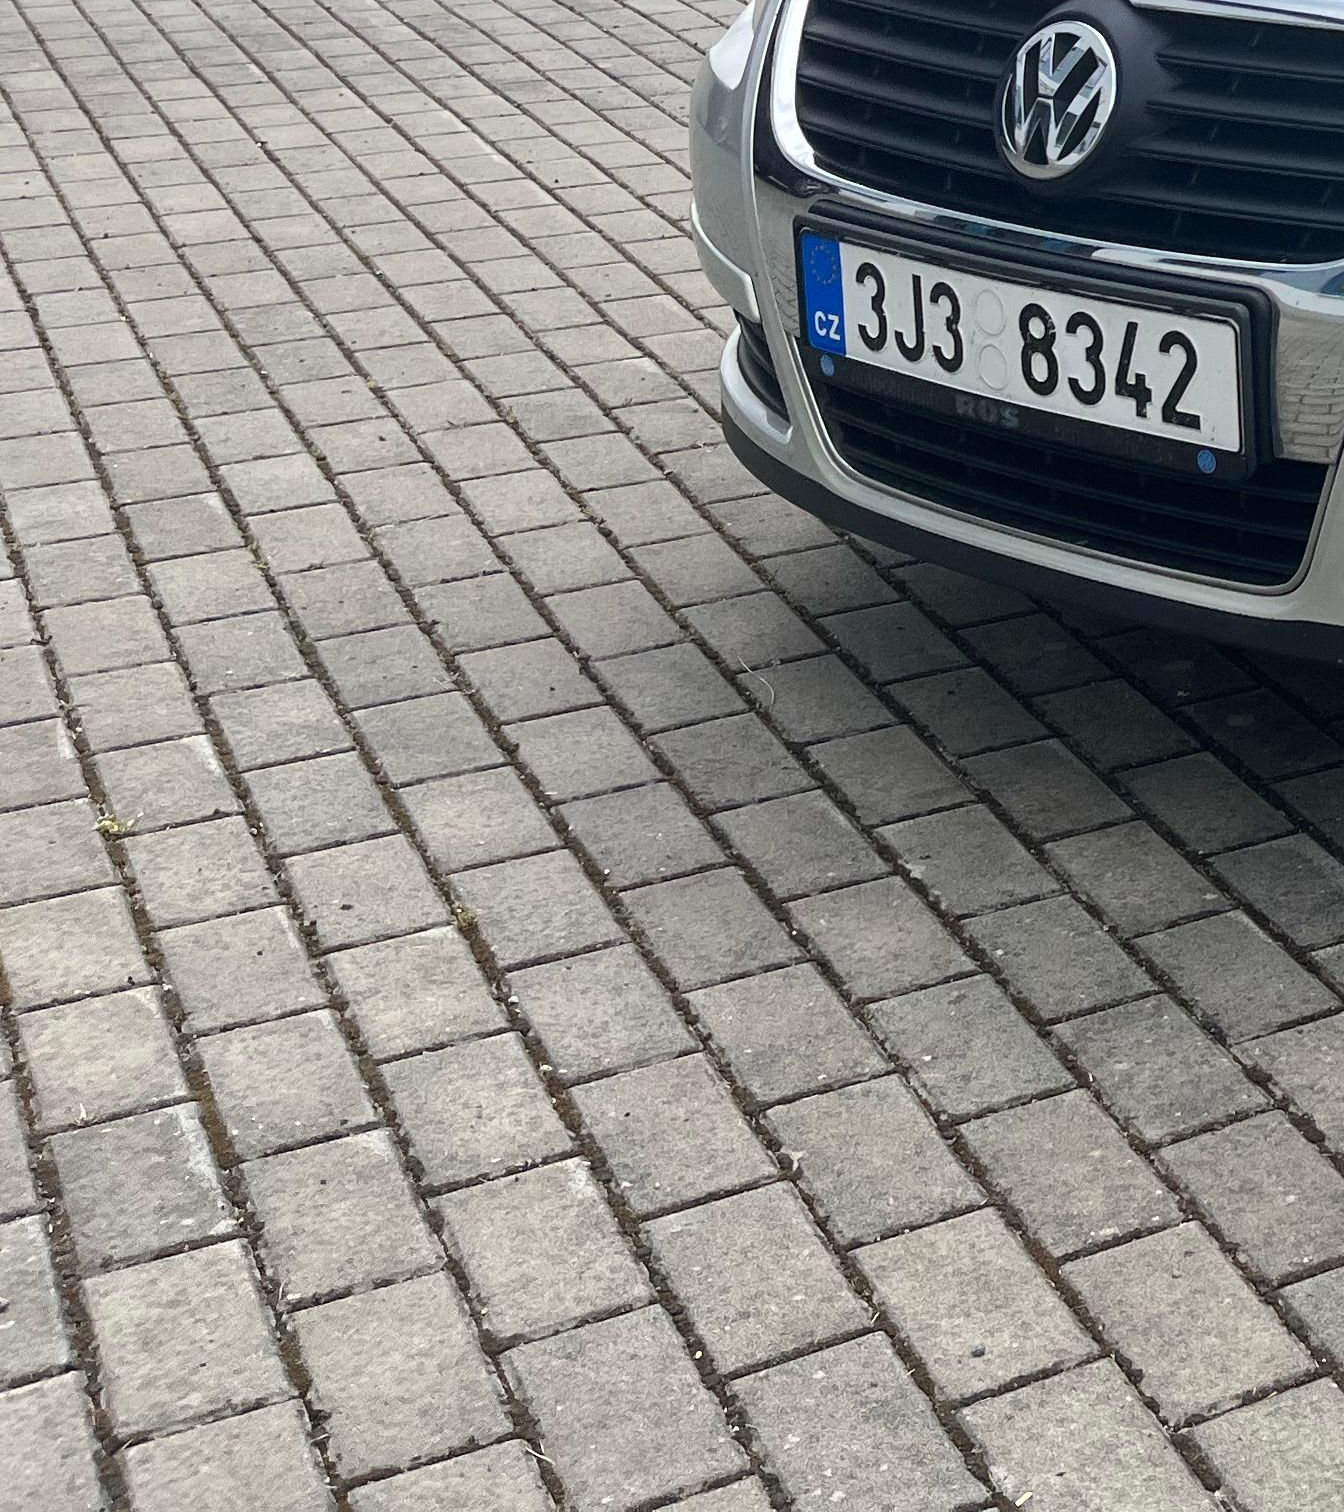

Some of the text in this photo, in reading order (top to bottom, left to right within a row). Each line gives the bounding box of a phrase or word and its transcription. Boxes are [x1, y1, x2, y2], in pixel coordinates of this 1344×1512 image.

[814, 310, 841, 341] CZ
[855, 261, 1202, 430] 3J3 8342
